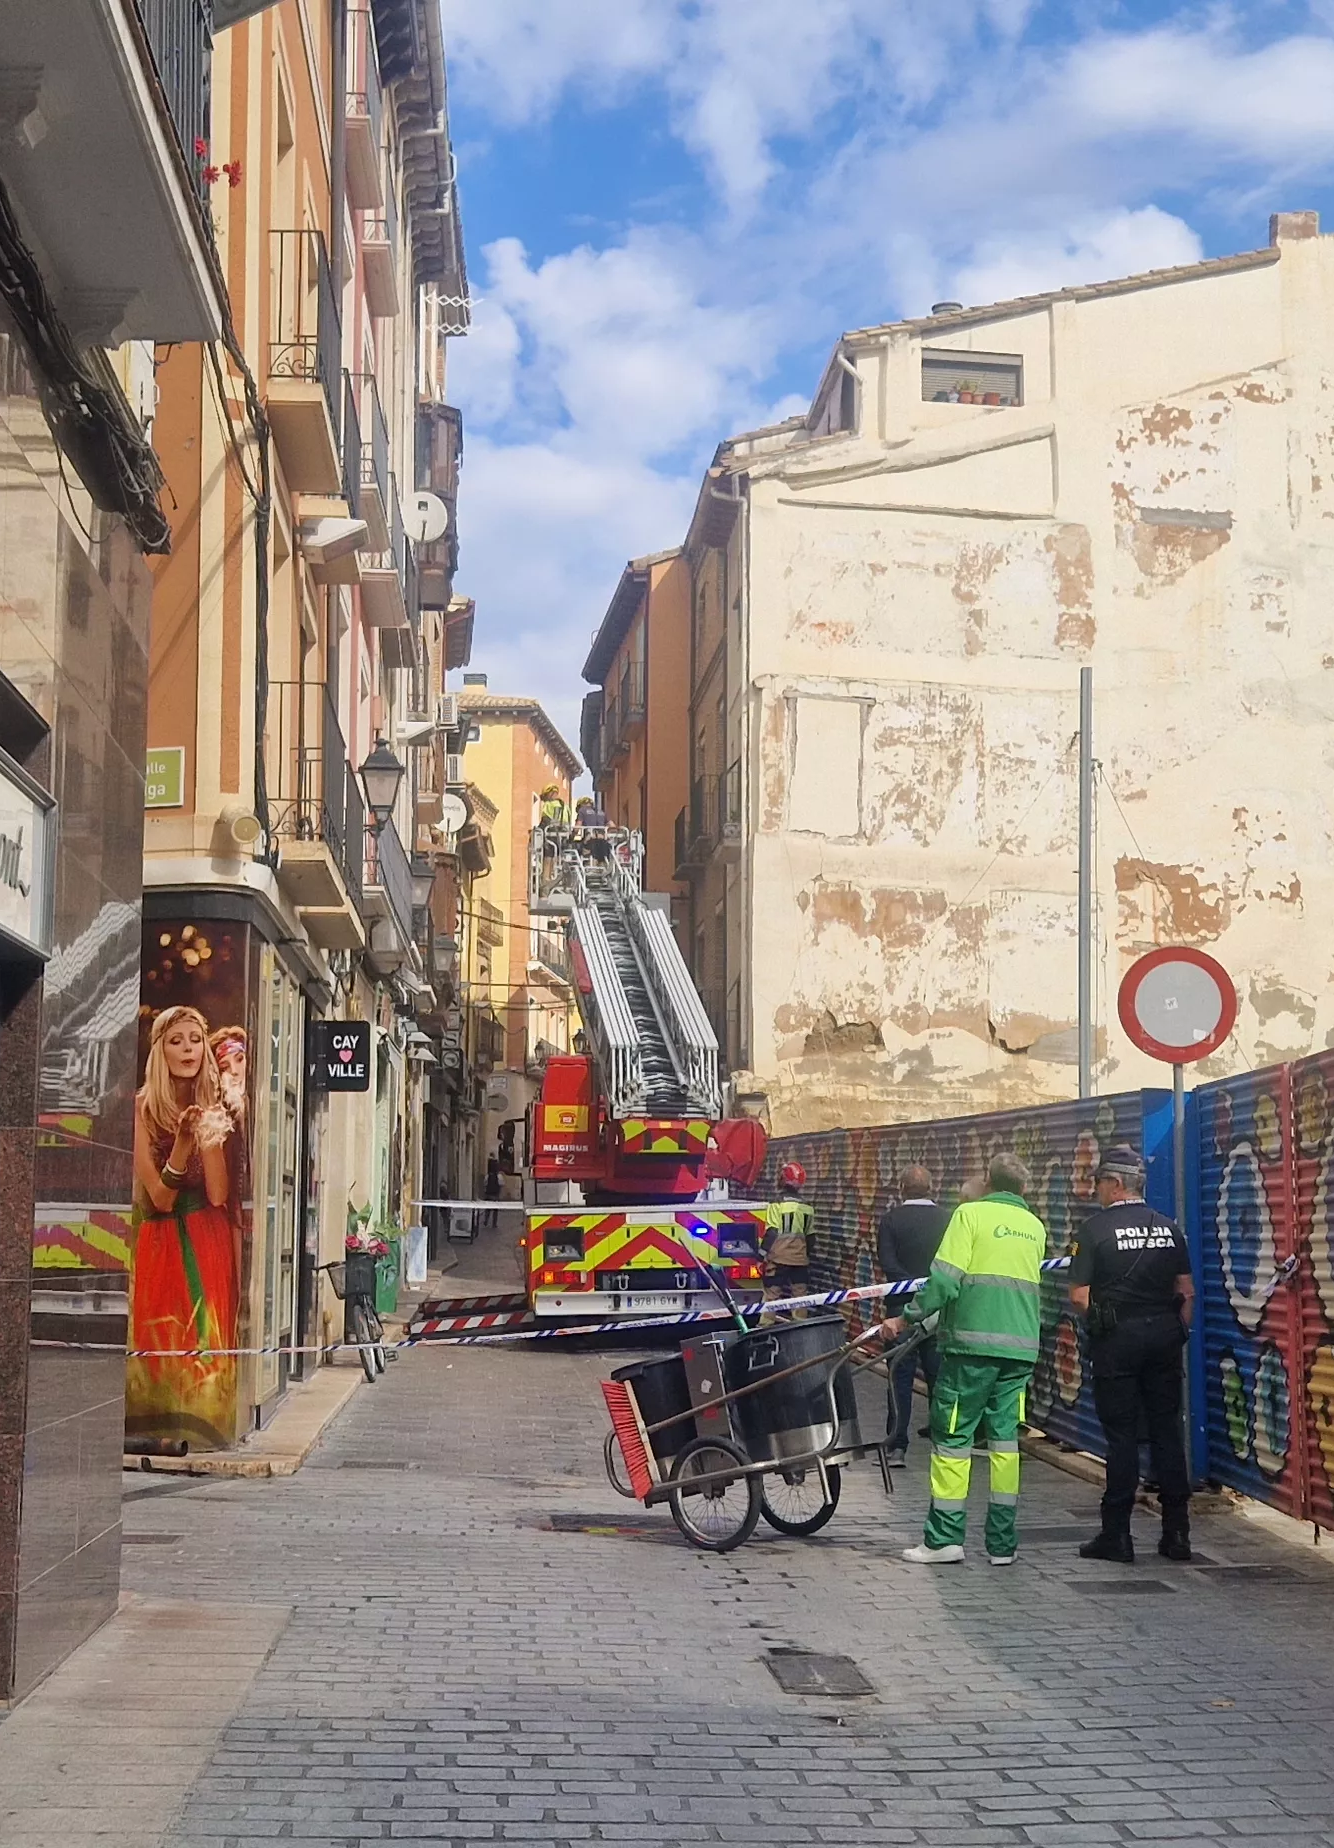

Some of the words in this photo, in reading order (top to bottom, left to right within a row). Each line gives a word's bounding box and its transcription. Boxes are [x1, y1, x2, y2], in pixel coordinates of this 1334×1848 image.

[145, 784, 166, 801] ga
[332, 1035, 360, 1050] CAY
[327, 1063, 365, 1078] VILLE
[543, 1144, 589, 1152] MAGIRUS
[555, 1154, 575, 1165] E-2
[634, 1296, 656, 1306] 9781
[660, 1295, 678, 1305] GYW
